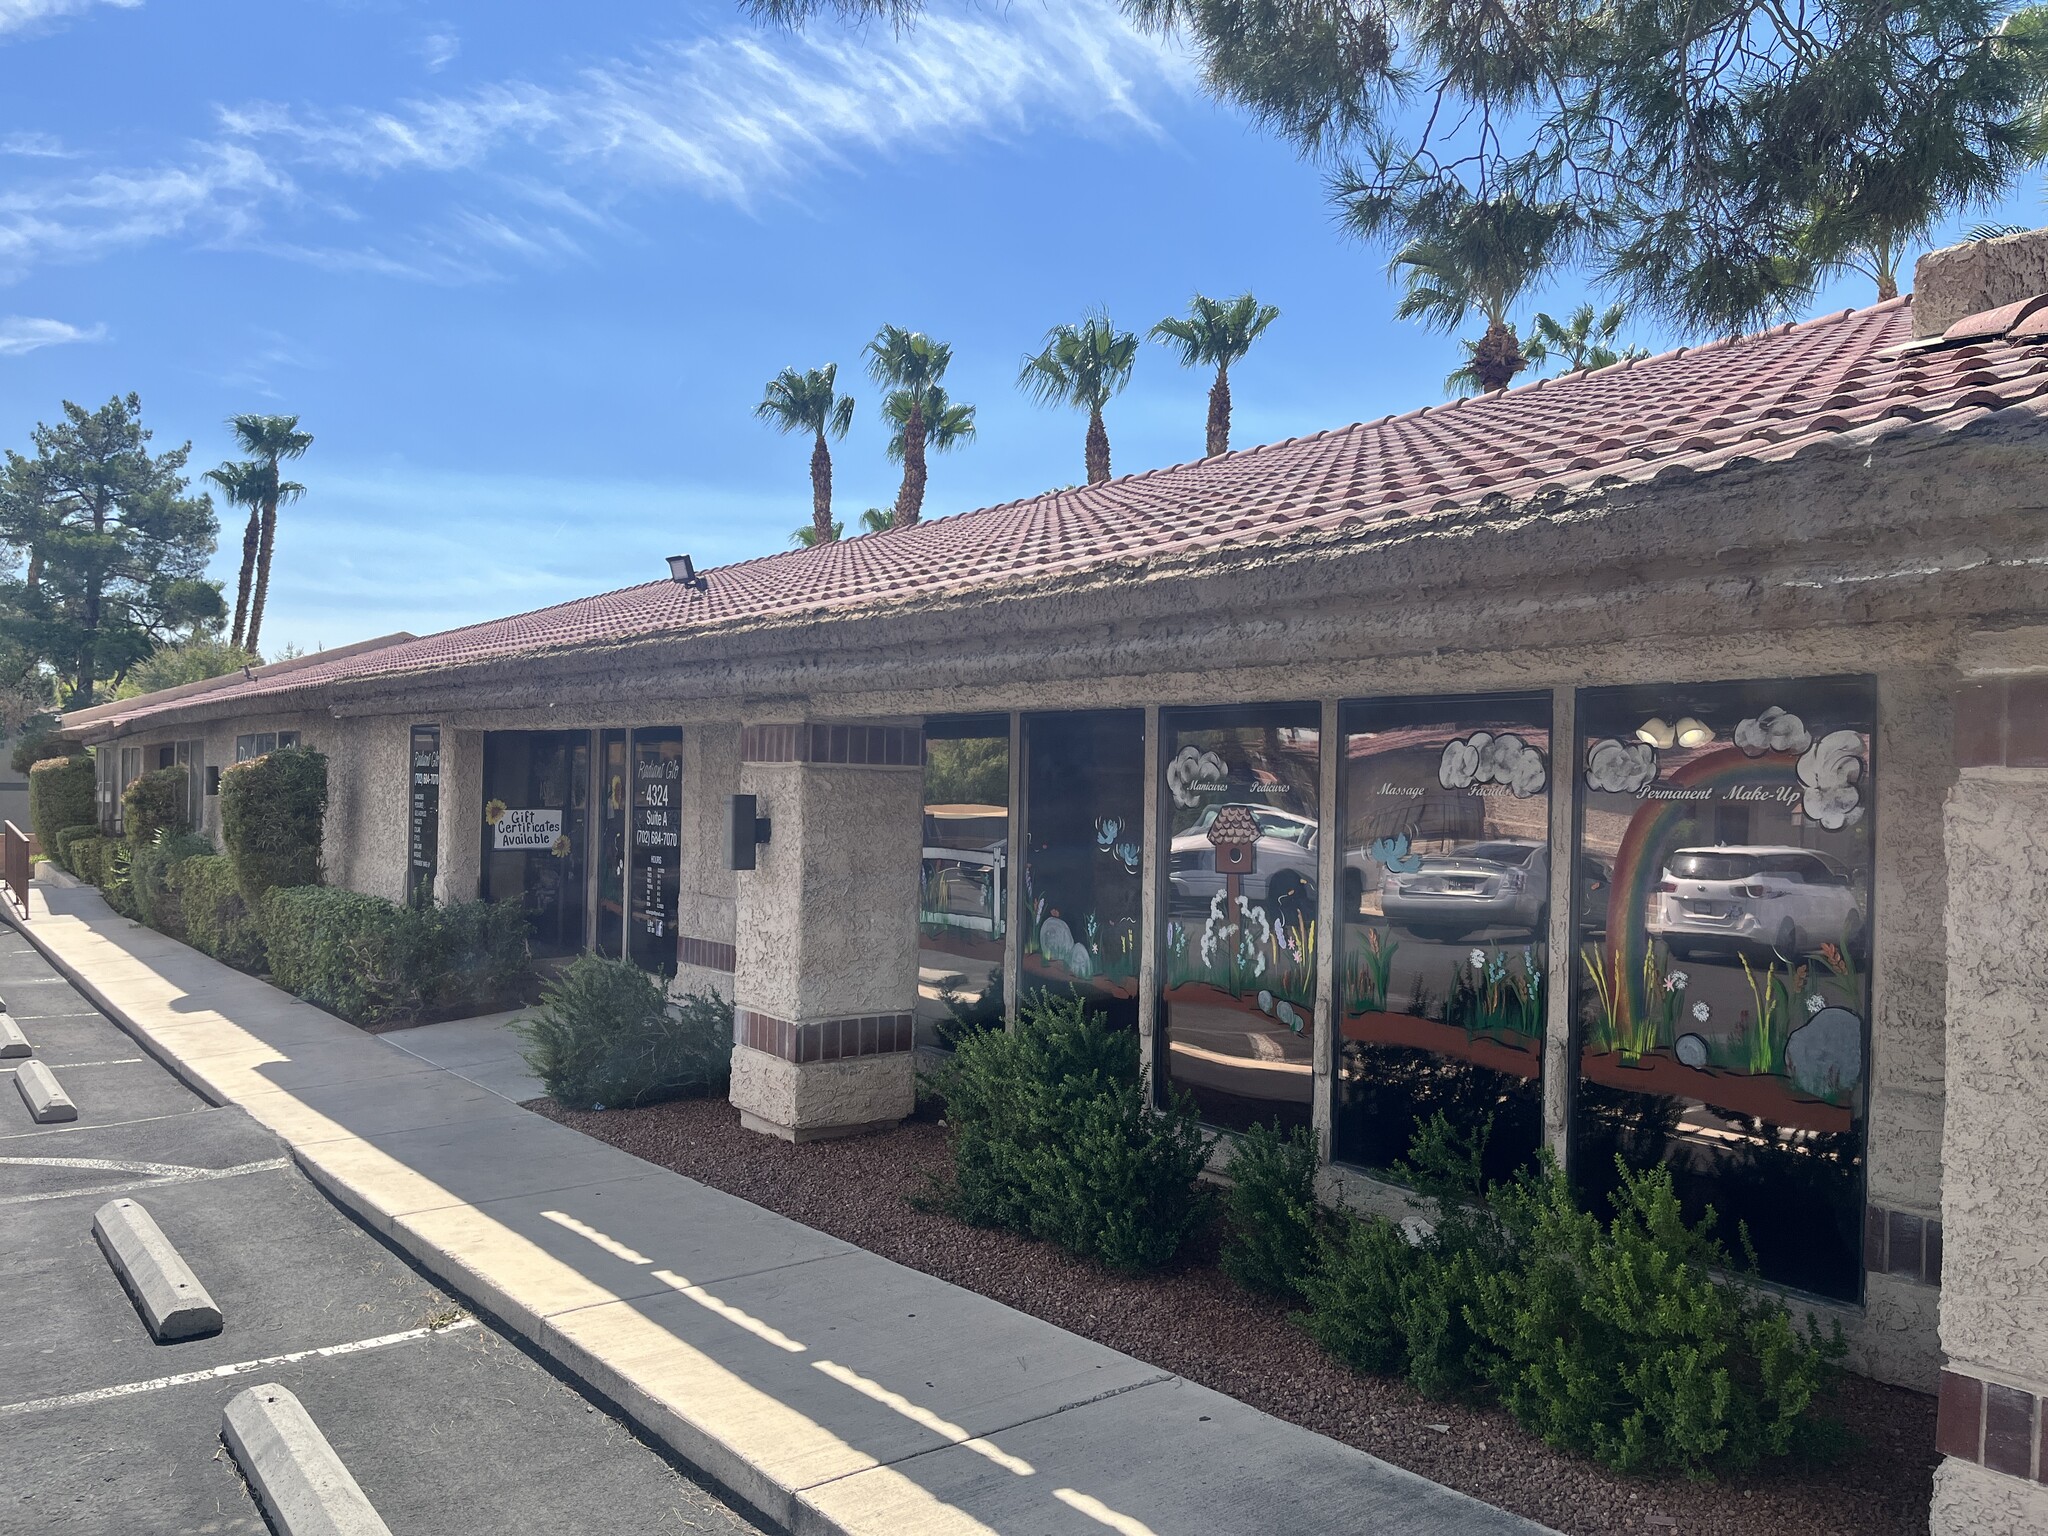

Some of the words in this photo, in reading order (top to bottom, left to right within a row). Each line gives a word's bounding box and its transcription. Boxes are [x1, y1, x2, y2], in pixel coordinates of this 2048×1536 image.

[638, 760, 665, 780] Radiant
[665, 760, 679, 780] Glo
[1186, 780, 1228, 792] Manicures
[1249, 781, 1290, 793] Pedicures
[1377, 782, 1425, 800] Massage
[646, 784, 669, 807] 4324
[1636, 785, 1713, 800] Permanent
[1722, 785, 1801, 806] Make-Up
[511, 811, 535, 824] Gift
[646, 810, 662, 826] Suite
[662, 811, 668, 827] A
[498, 820, 560, 834] Certificates
[502, 833, 550, 847] Available
[636, 829, 650, 847] (702)
[650, 830, 678, 847] 684-7070
[650, 855, 662, 865] HOURS
